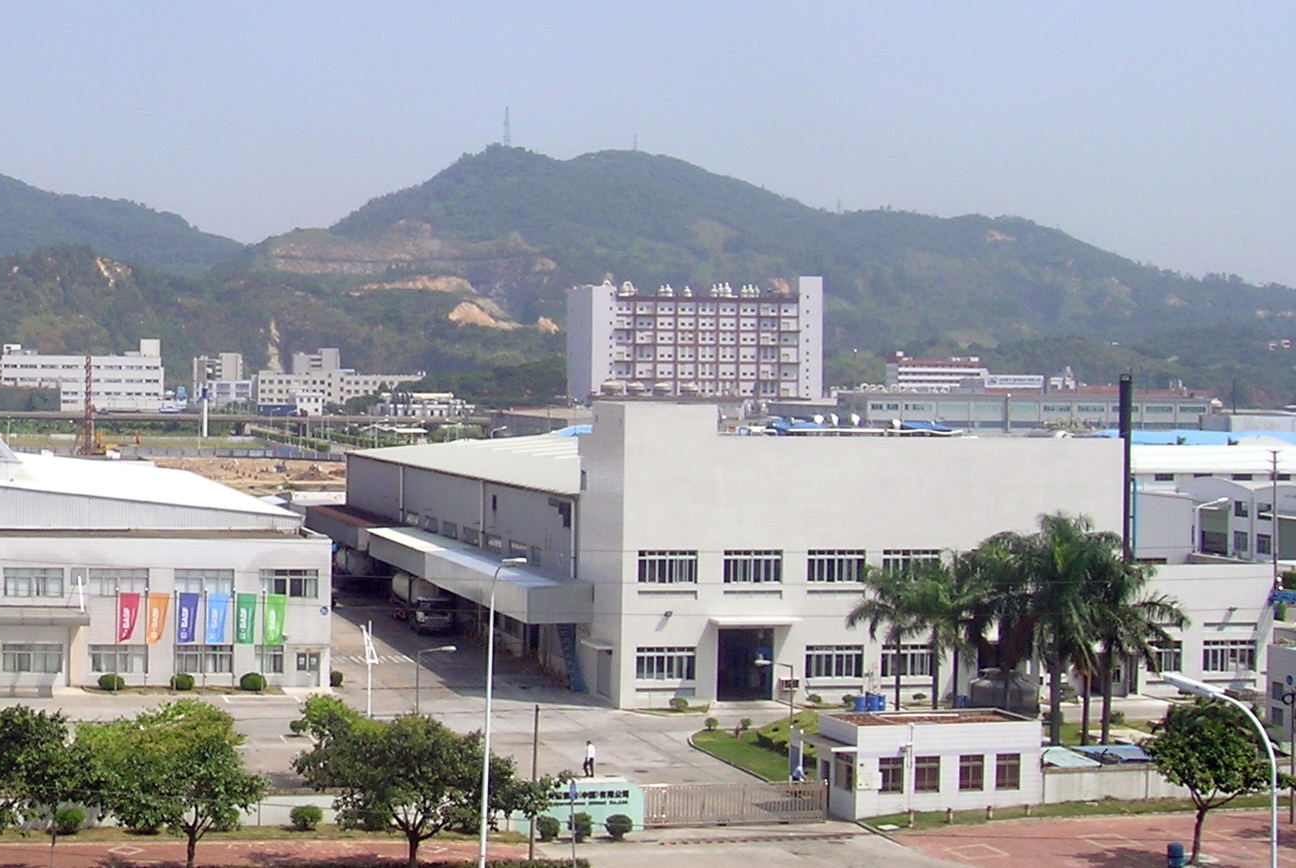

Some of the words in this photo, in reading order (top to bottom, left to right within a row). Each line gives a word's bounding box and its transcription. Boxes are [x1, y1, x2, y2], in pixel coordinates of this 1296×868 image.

[122, 607, 130, 629] BASF
[180, 607, 189, 628] BASF
[239, 607, 247, 629] BASF
